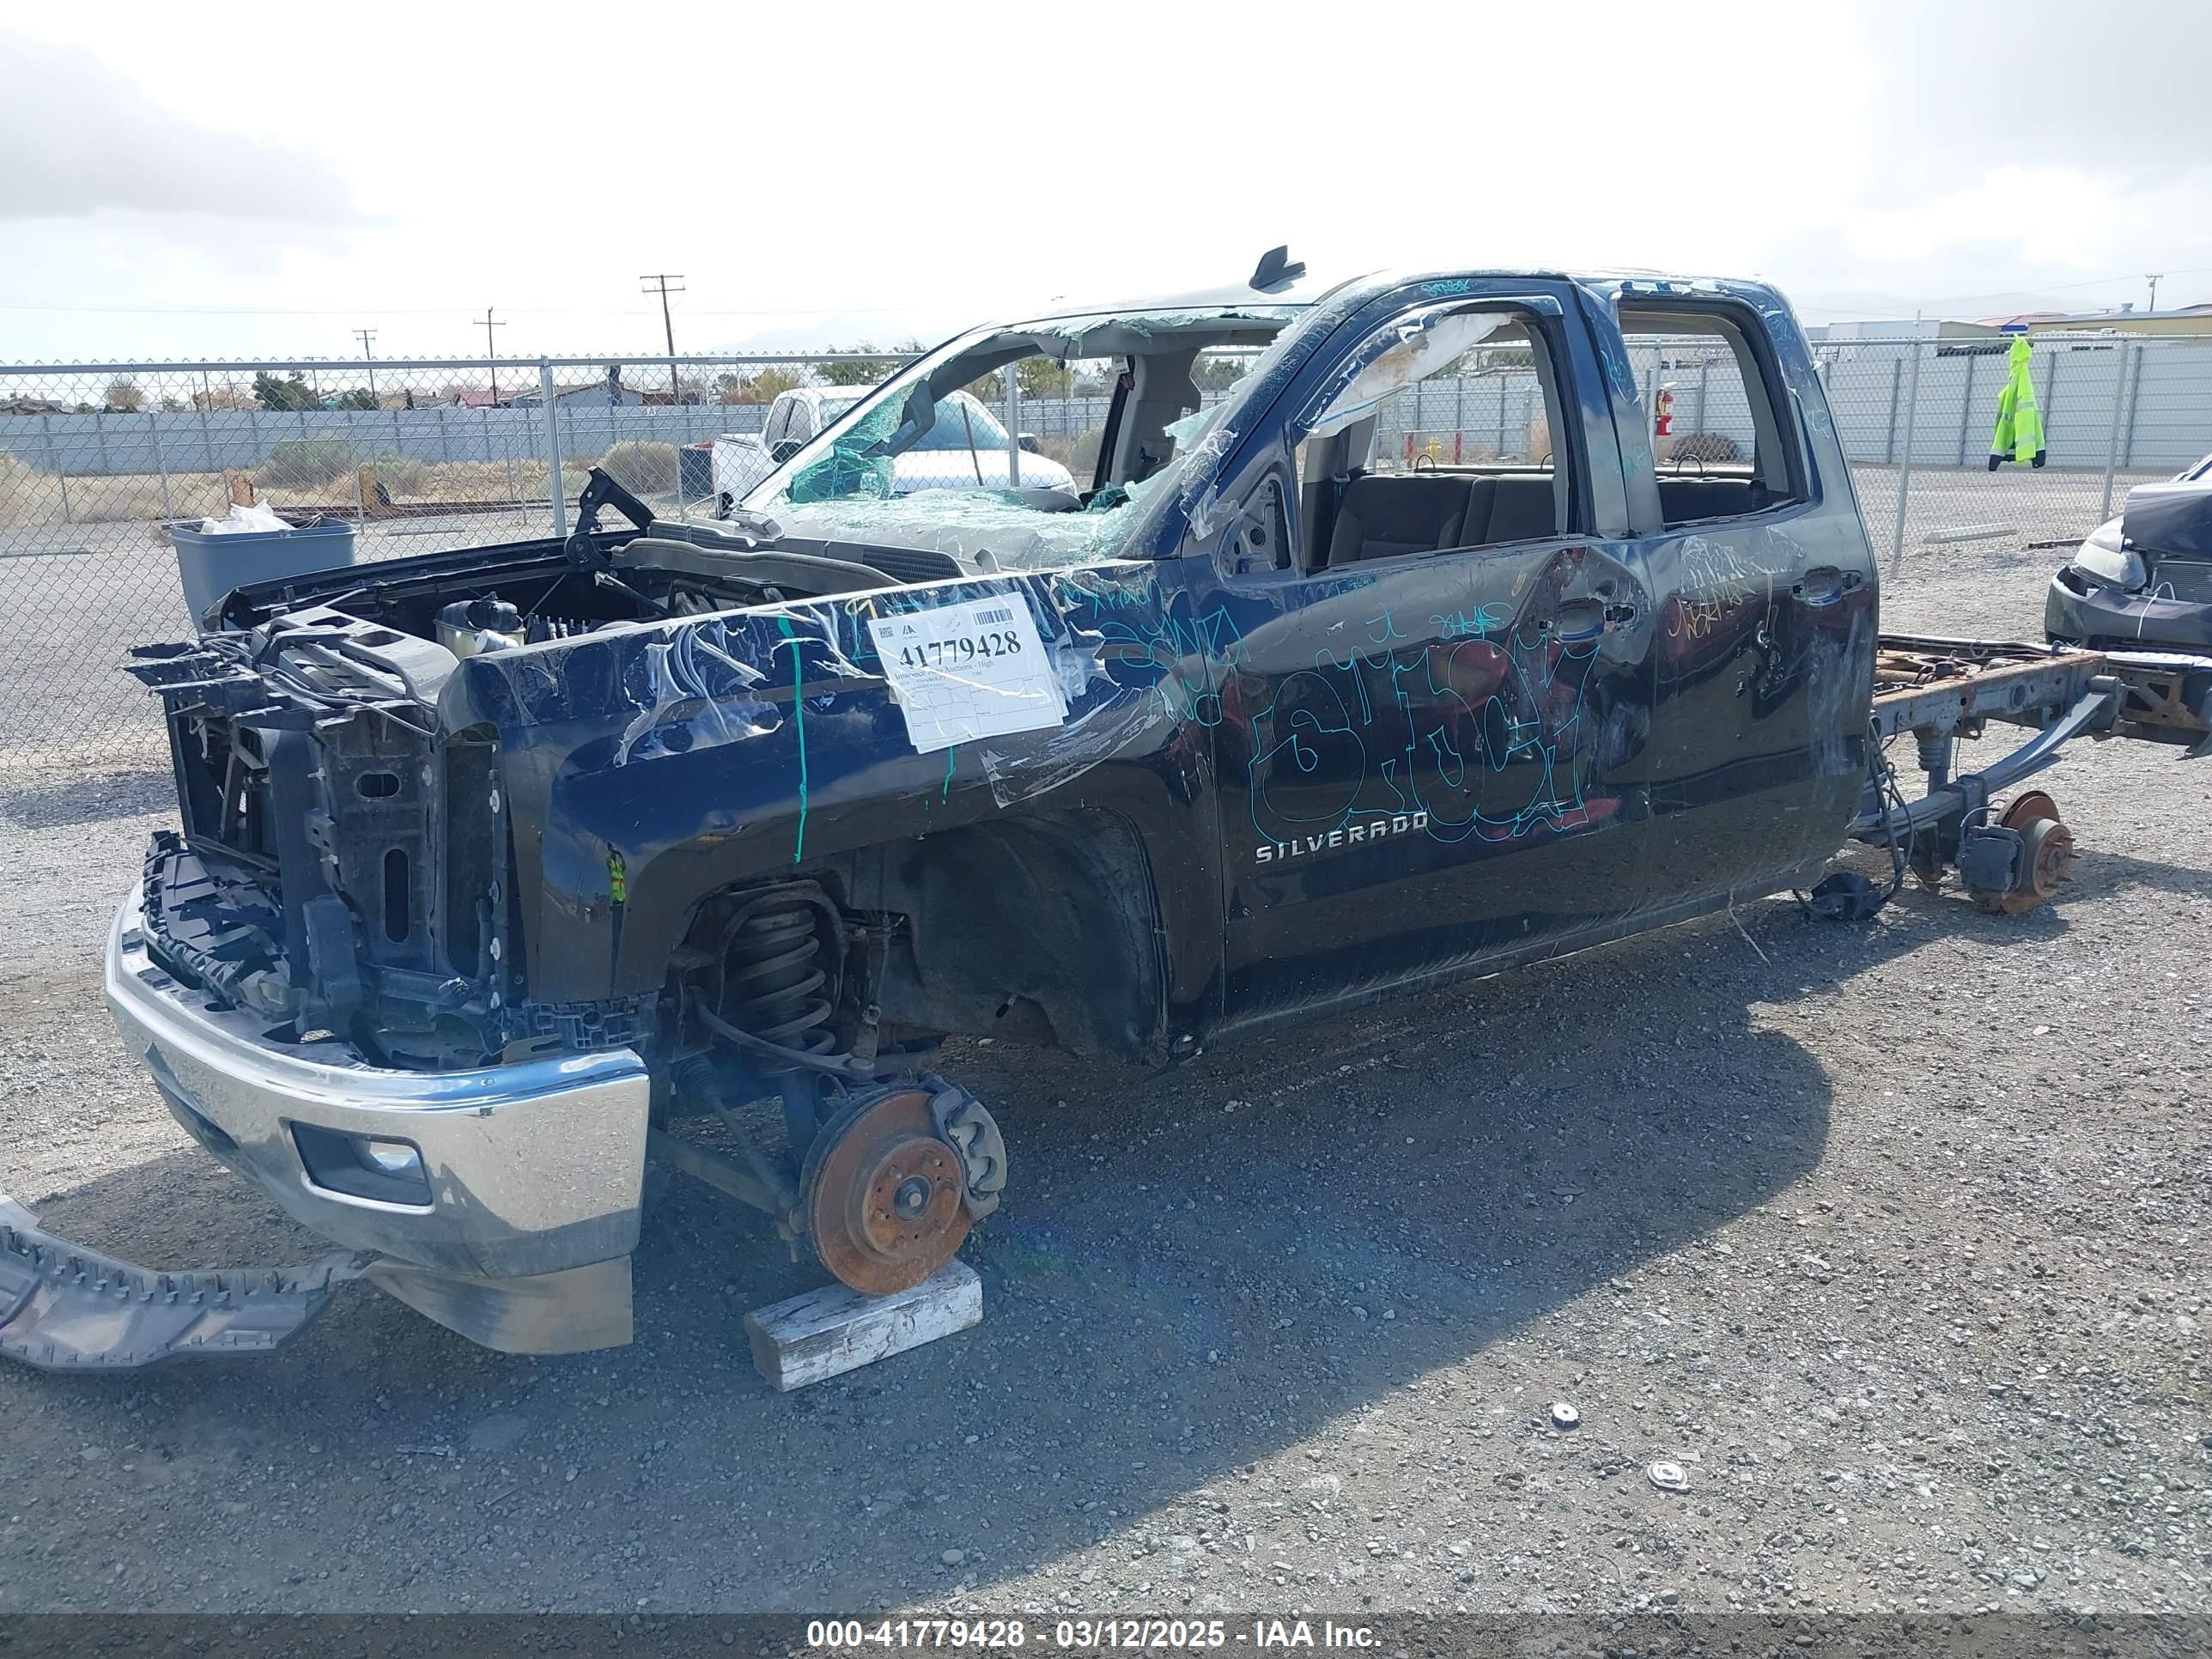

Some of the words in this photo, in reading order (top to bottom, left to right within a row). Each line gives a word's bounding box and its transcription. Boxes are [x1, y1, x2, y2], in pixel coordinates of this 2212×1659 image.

[900, 630, 1021, 669] 41779428
[945, 664, 972, 674] Auctions
[978, 659, 994, 669] High
[1255, 811, 1427, 864] SILVERADO
